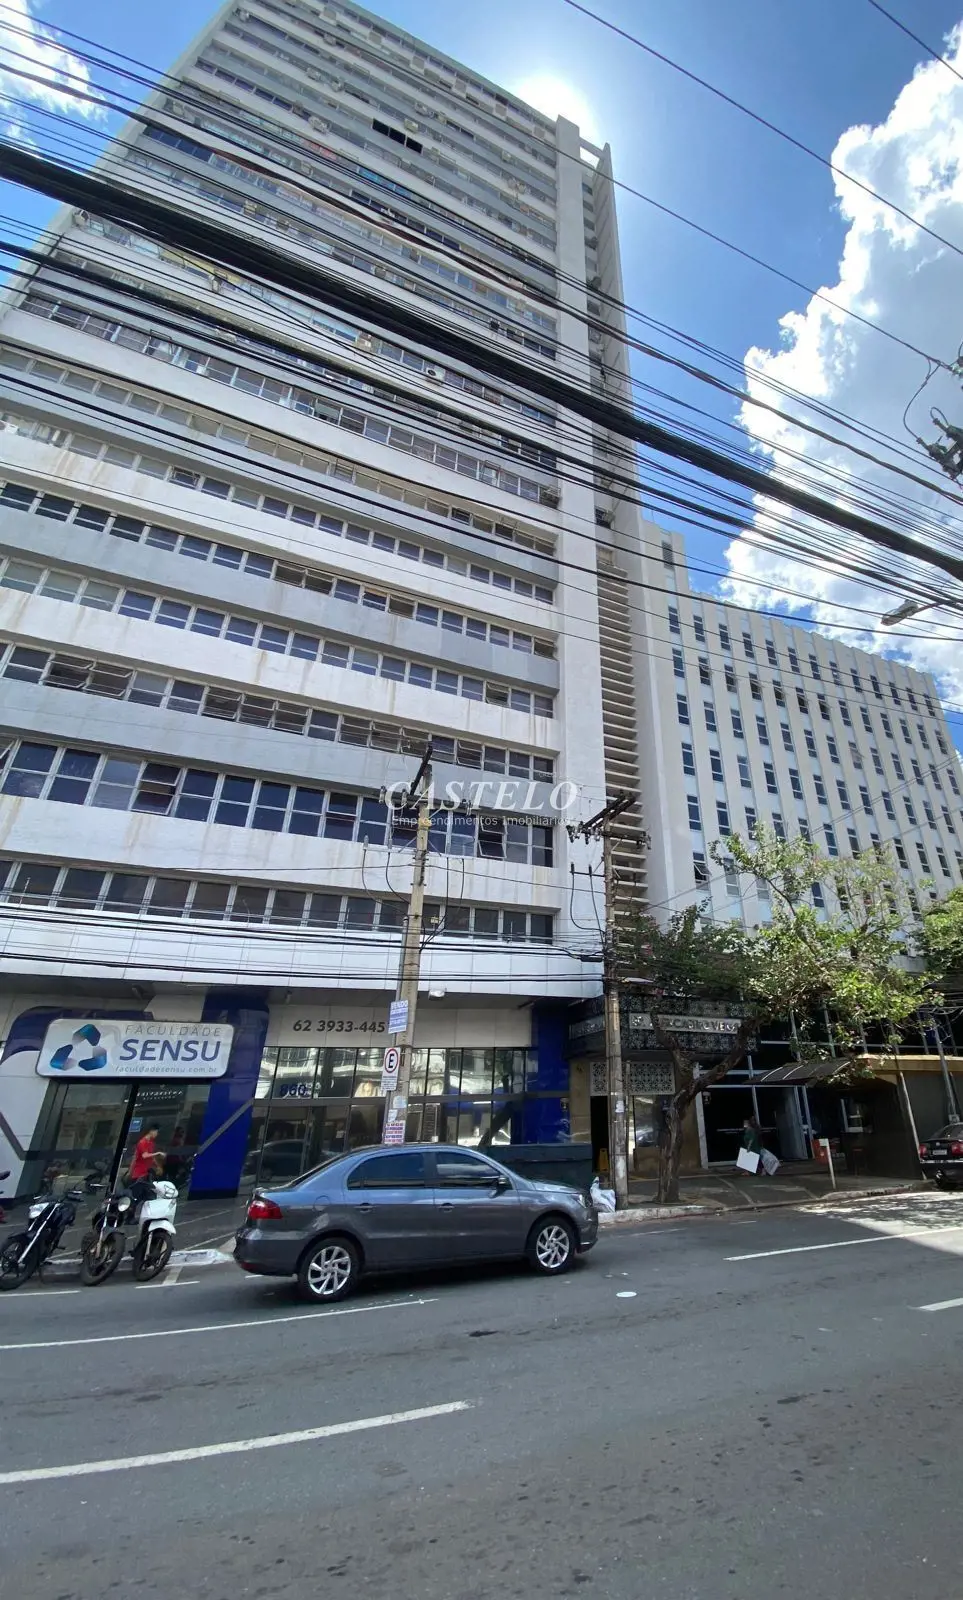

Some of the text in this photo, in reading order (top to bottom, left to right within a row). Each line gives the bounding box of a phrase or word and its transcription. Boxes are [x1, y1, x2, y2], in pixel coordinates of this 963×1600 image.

[125, 1025, 223, 1037] FACULDADE
[292, 1020, 312, 1032] 62
[316, 1020, 388, 1033] 3933-445
[119, 1039, 221, 1062] SENSU
[388, 1053, 395, 1069] E
